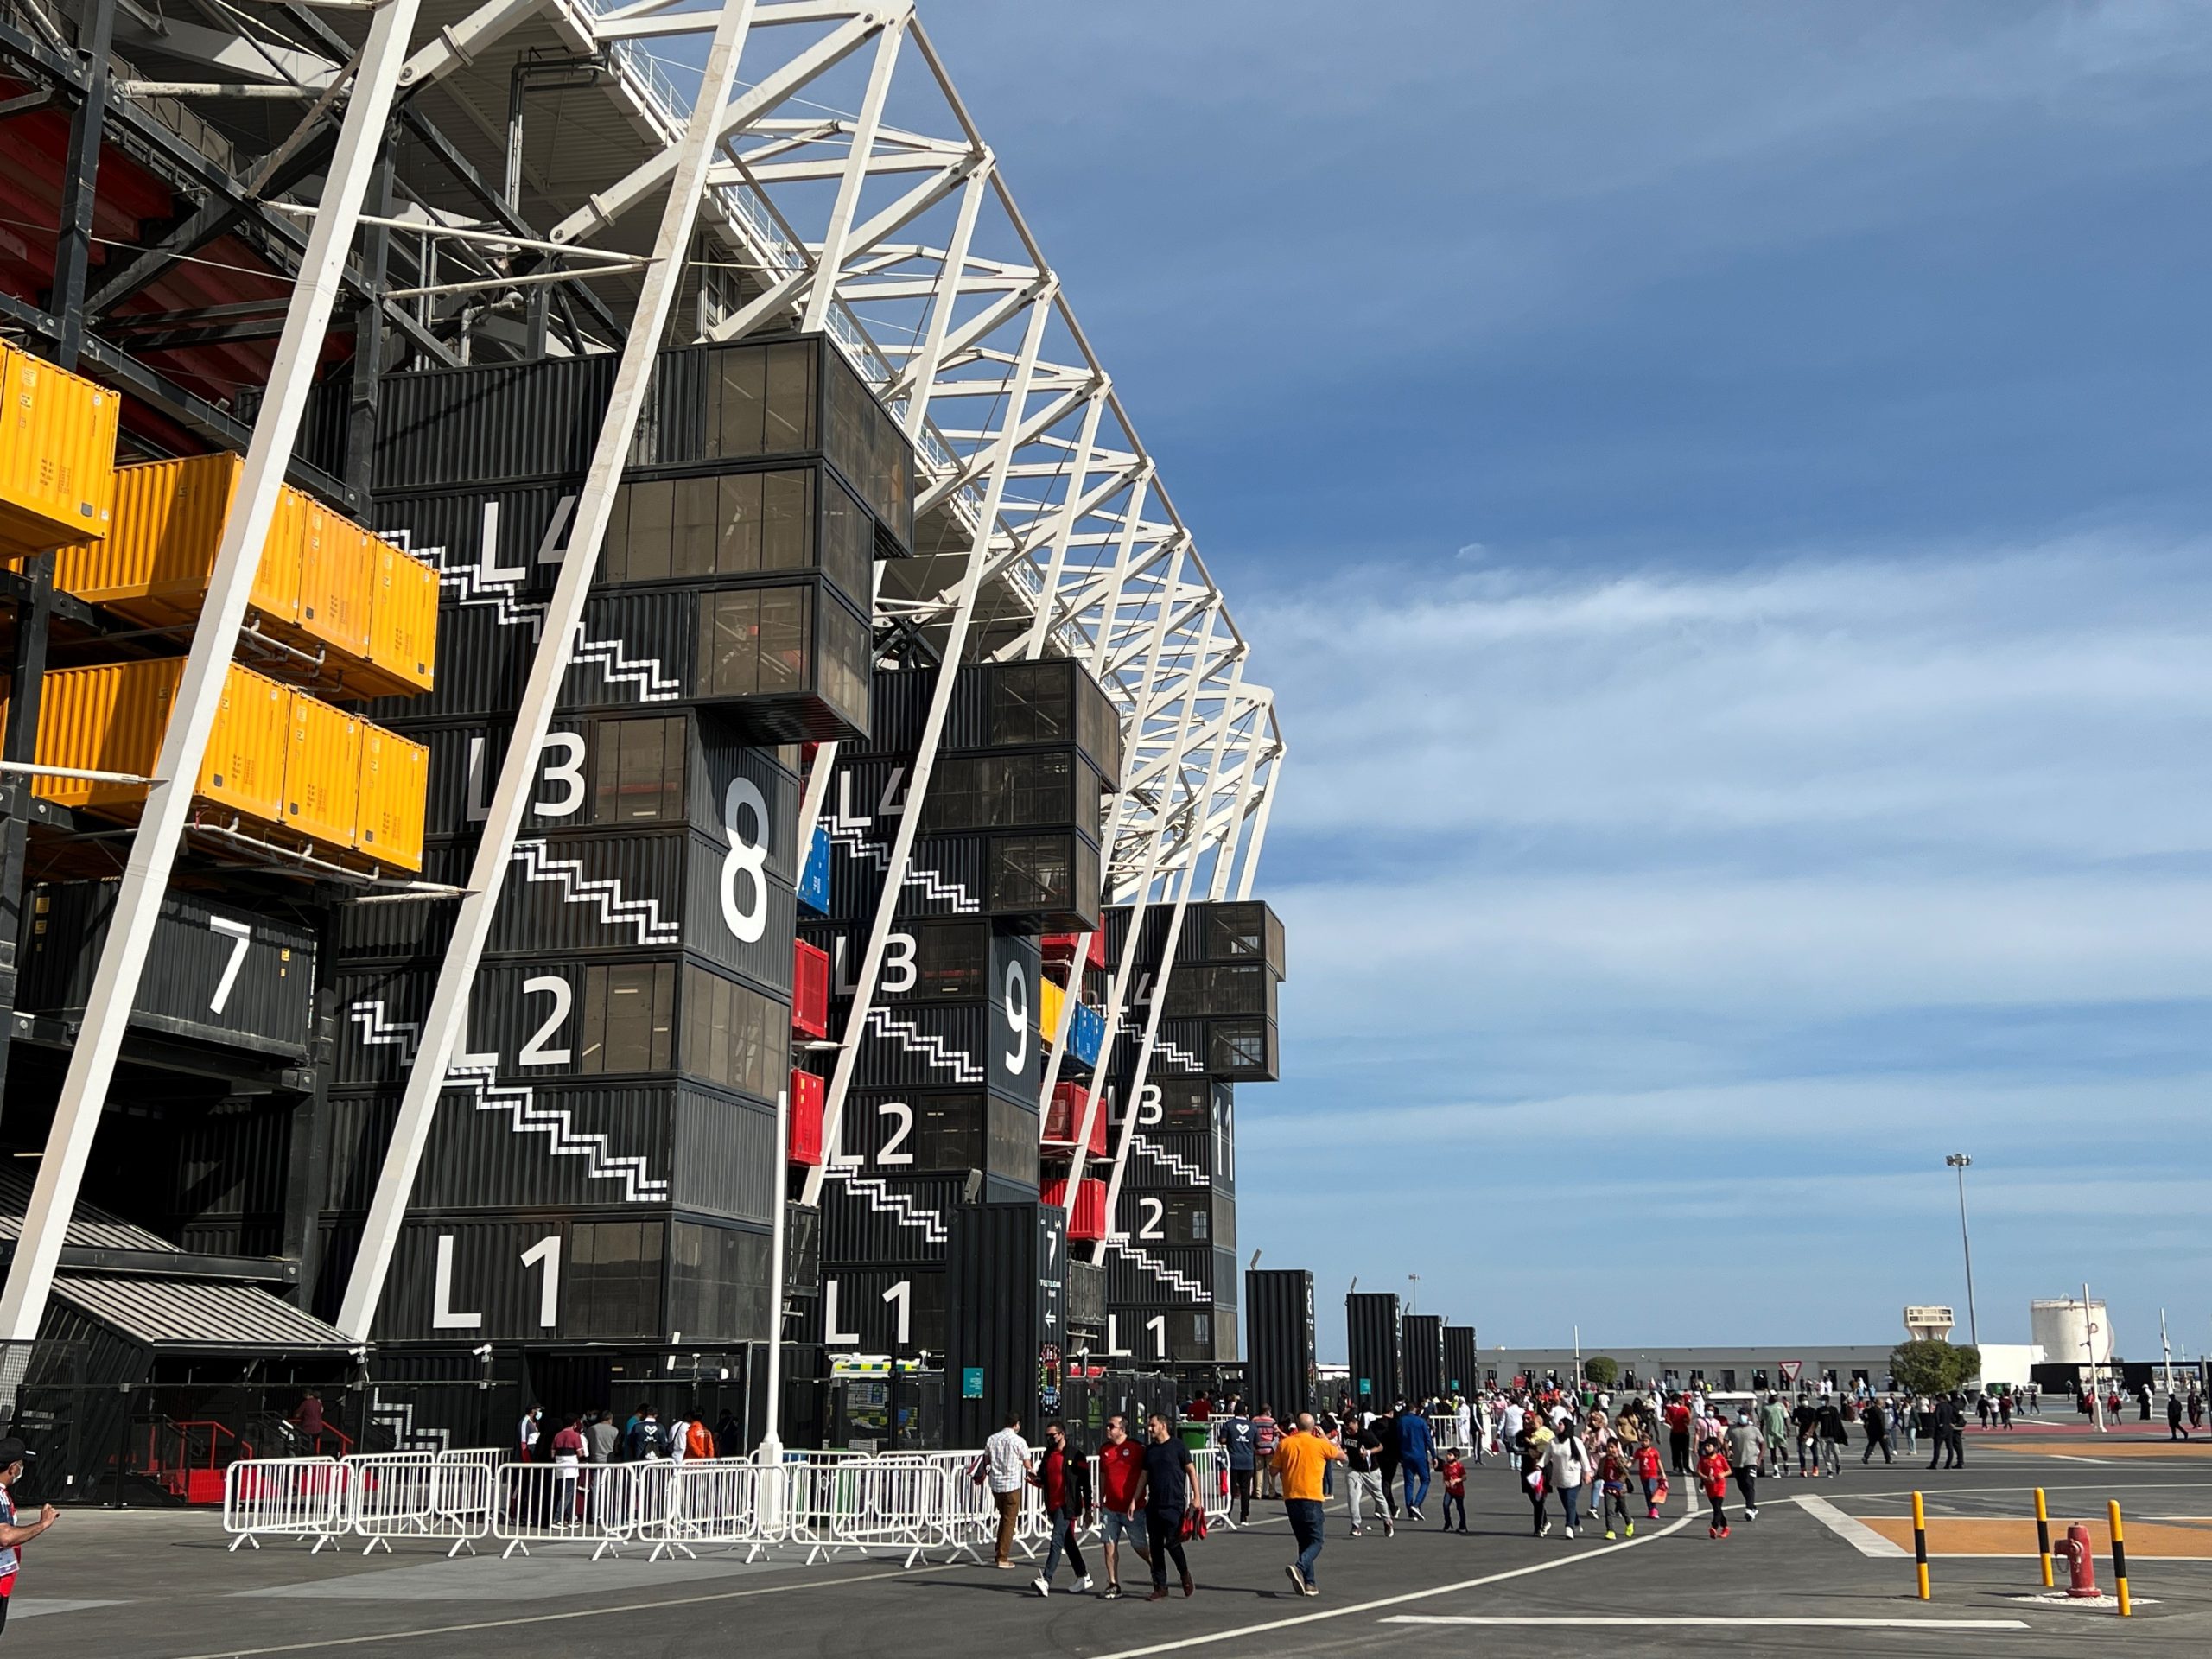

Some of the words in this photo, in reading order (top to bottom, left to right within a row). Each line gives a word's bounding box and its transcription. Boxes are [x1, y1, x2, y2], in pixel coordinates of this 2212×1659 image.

[467, 732, 586, 822] L3
[721, 777, 770, 943] 8
[210, 915, 251, 1015] 7
[835, 933, 917, 995] L3
[451, 976, 572, 1067] L2
[1005, 959, 1028, 1076] 9
[830, 1103, 913, 1166] L2
[1108, 1084, 1163, 1126] L3
[1213, 1096, 1233, 1181] 11
[433, 1235, 561, 1328] L1
[1047, 1230, 1057, 1271] 7
[825, 1280, 910, 1344] L1
[1109, 1314, 1165, 1357] L1
